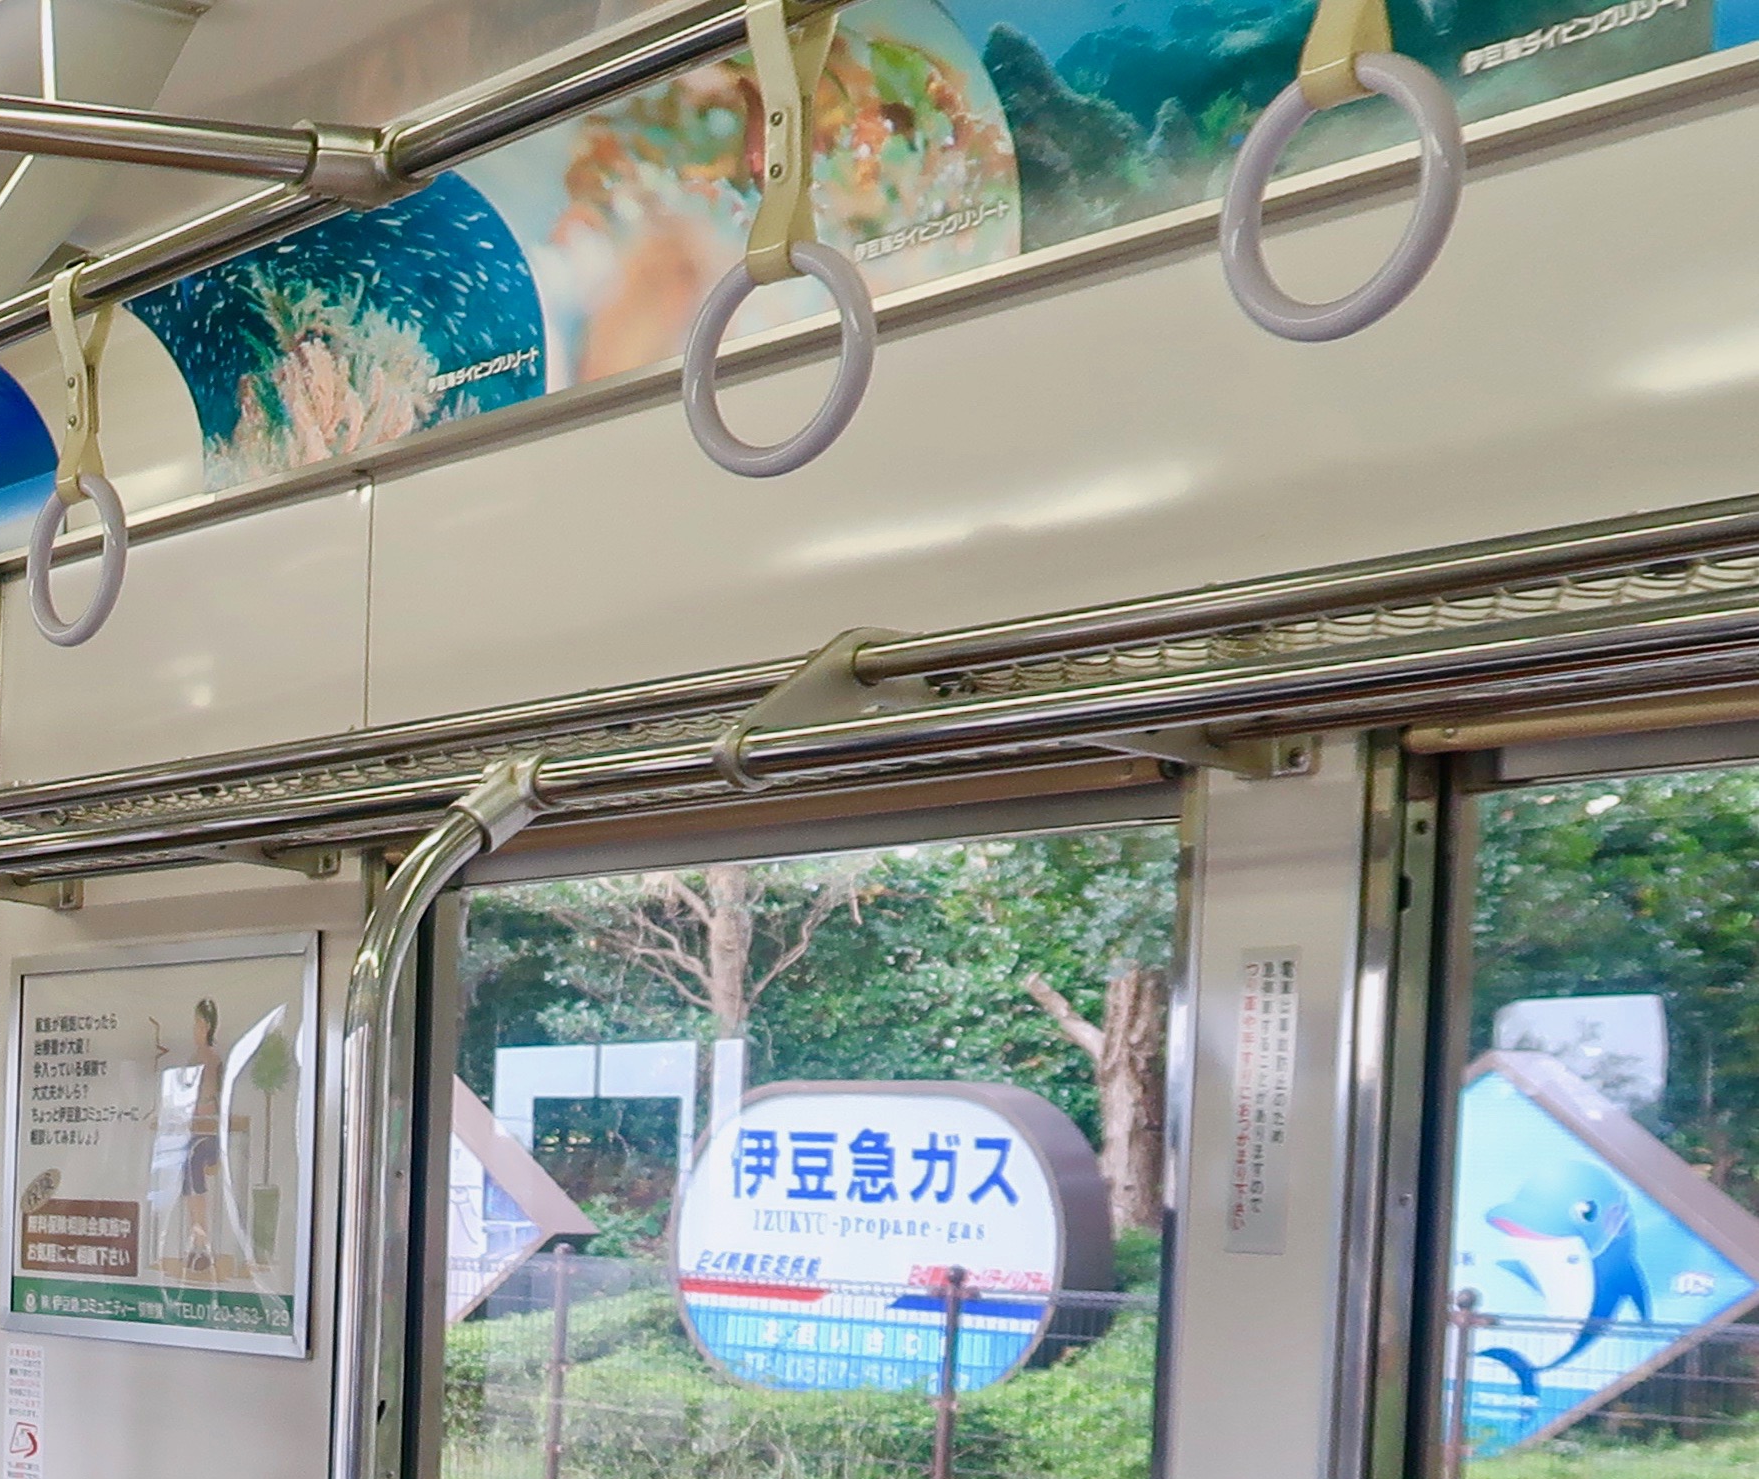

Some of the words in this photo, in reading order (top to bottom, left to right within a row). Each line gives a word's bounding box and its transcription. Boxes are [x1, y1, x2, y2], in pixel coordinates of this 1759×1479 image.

[733, 1128, 1019, 1206] 伊豆急ガス
